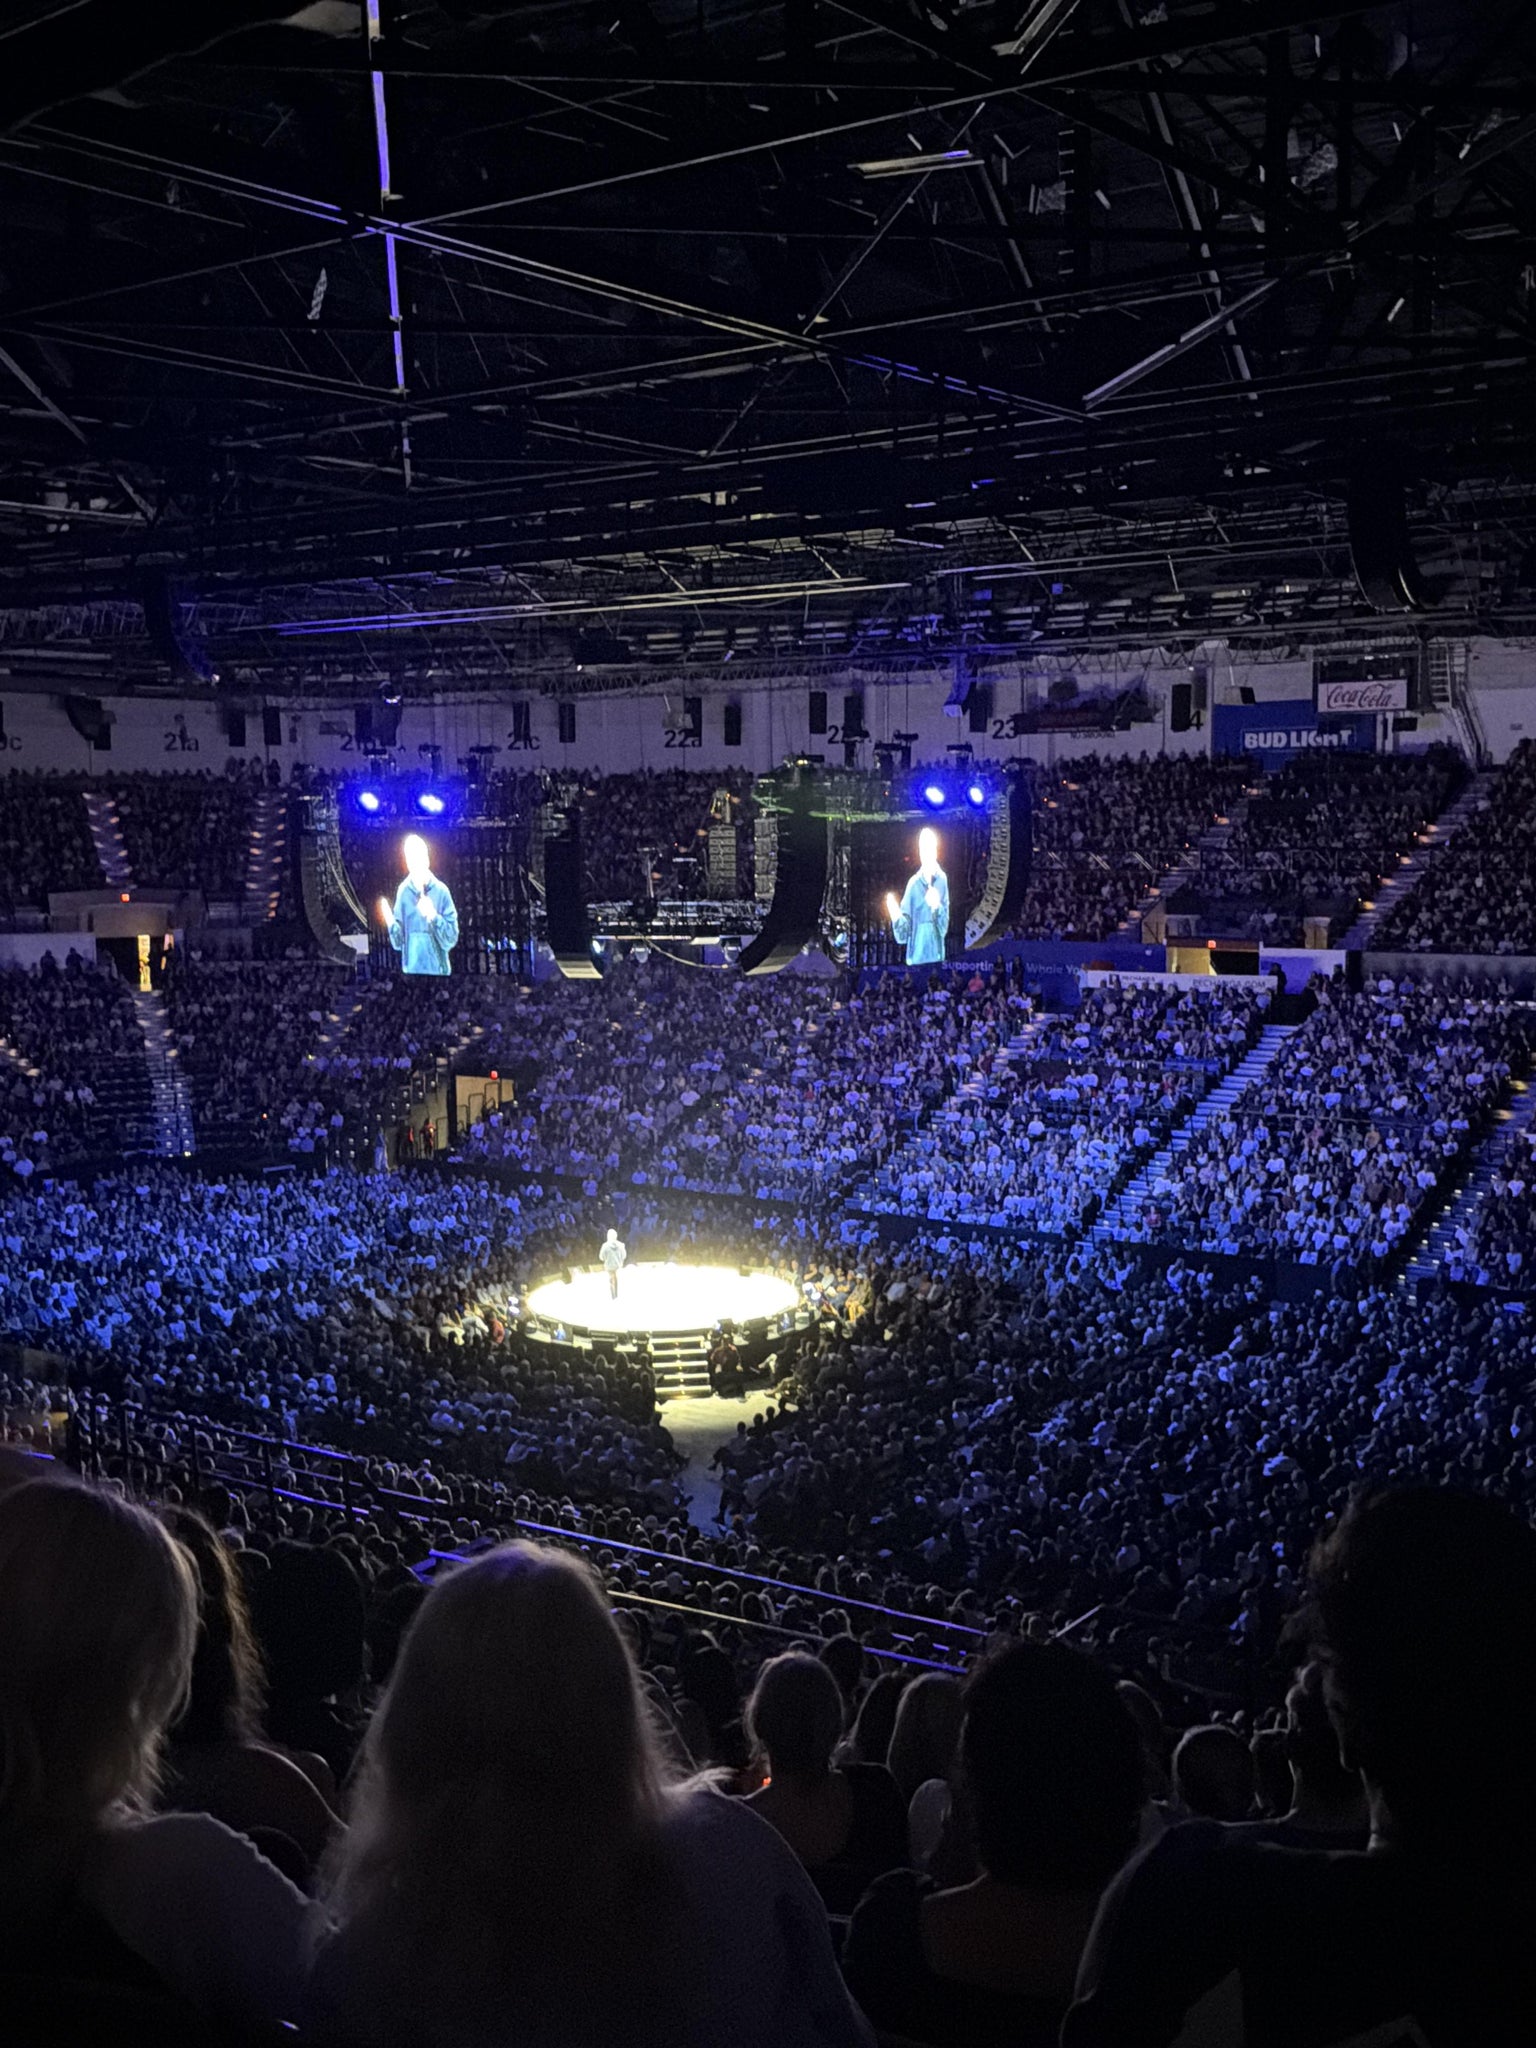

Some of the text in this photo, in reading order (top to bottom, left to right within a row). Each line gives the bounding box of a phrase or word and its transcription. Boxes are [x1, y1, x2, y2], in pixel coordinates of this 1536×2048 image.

[1244, 732, 1288, 749] BUD
[942, 960, 1002, 973] Supportin
[1066, 964, 1081, 975] Yo
